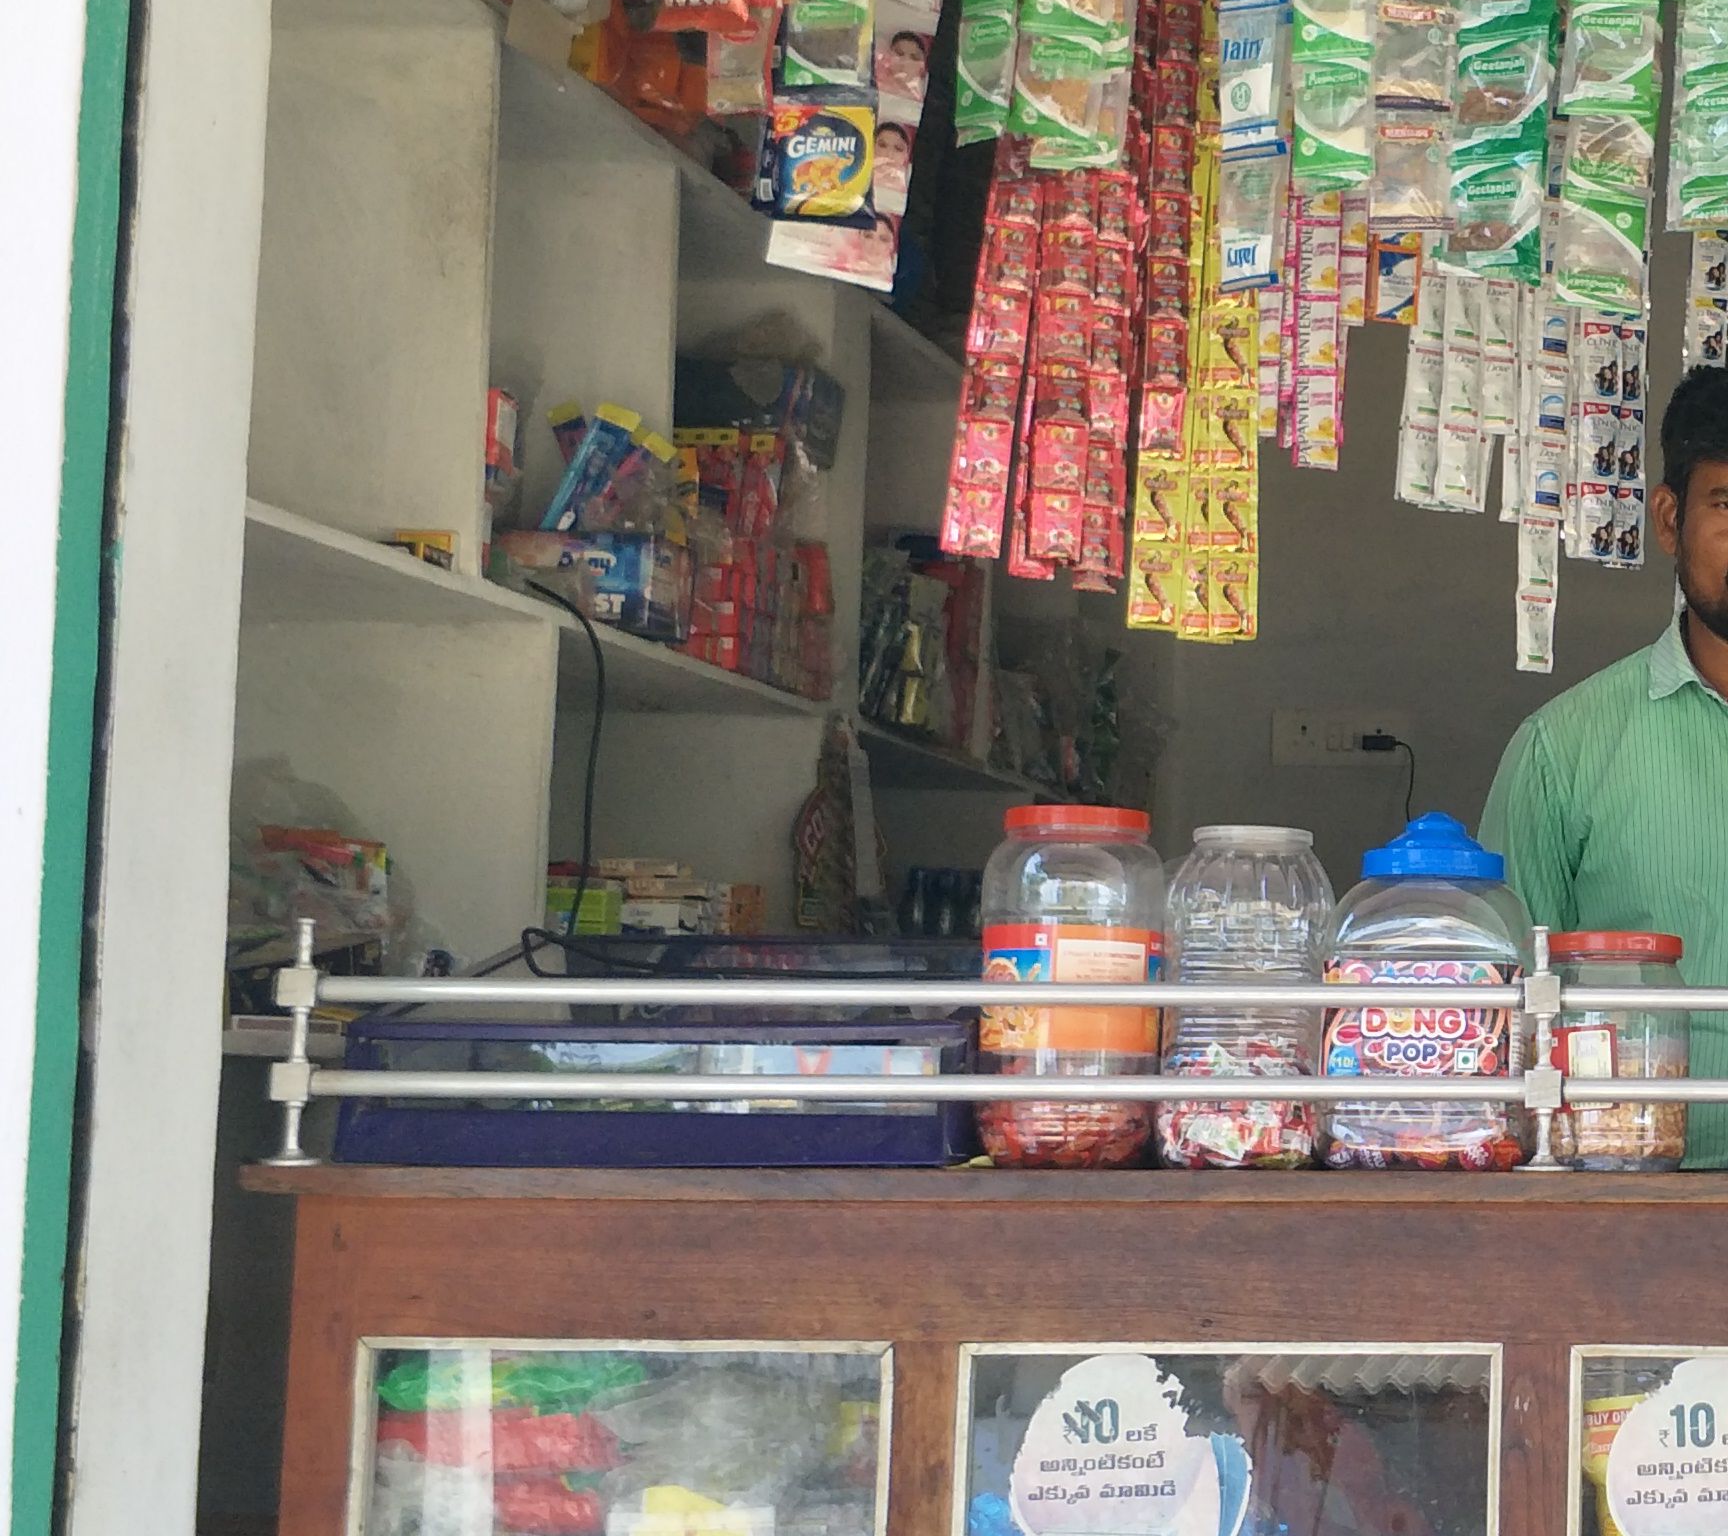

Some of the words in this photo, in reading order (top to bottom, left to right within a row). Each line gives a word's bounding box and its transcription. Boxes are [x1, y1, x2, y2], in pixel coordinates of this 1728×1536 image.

[786, 135, 857, 157] GEMINI
[1386, 1043, 1438, 1063] POP
[1039, 1450, 1166, 1477] అన్నింటికంటే
[1027, 1484, 1091, 1506] ఎక్కువ
[1099, 1479, 1178, 1499] మామిడి
[1625, 1488, 1689, 1511] ఎక్కువ
